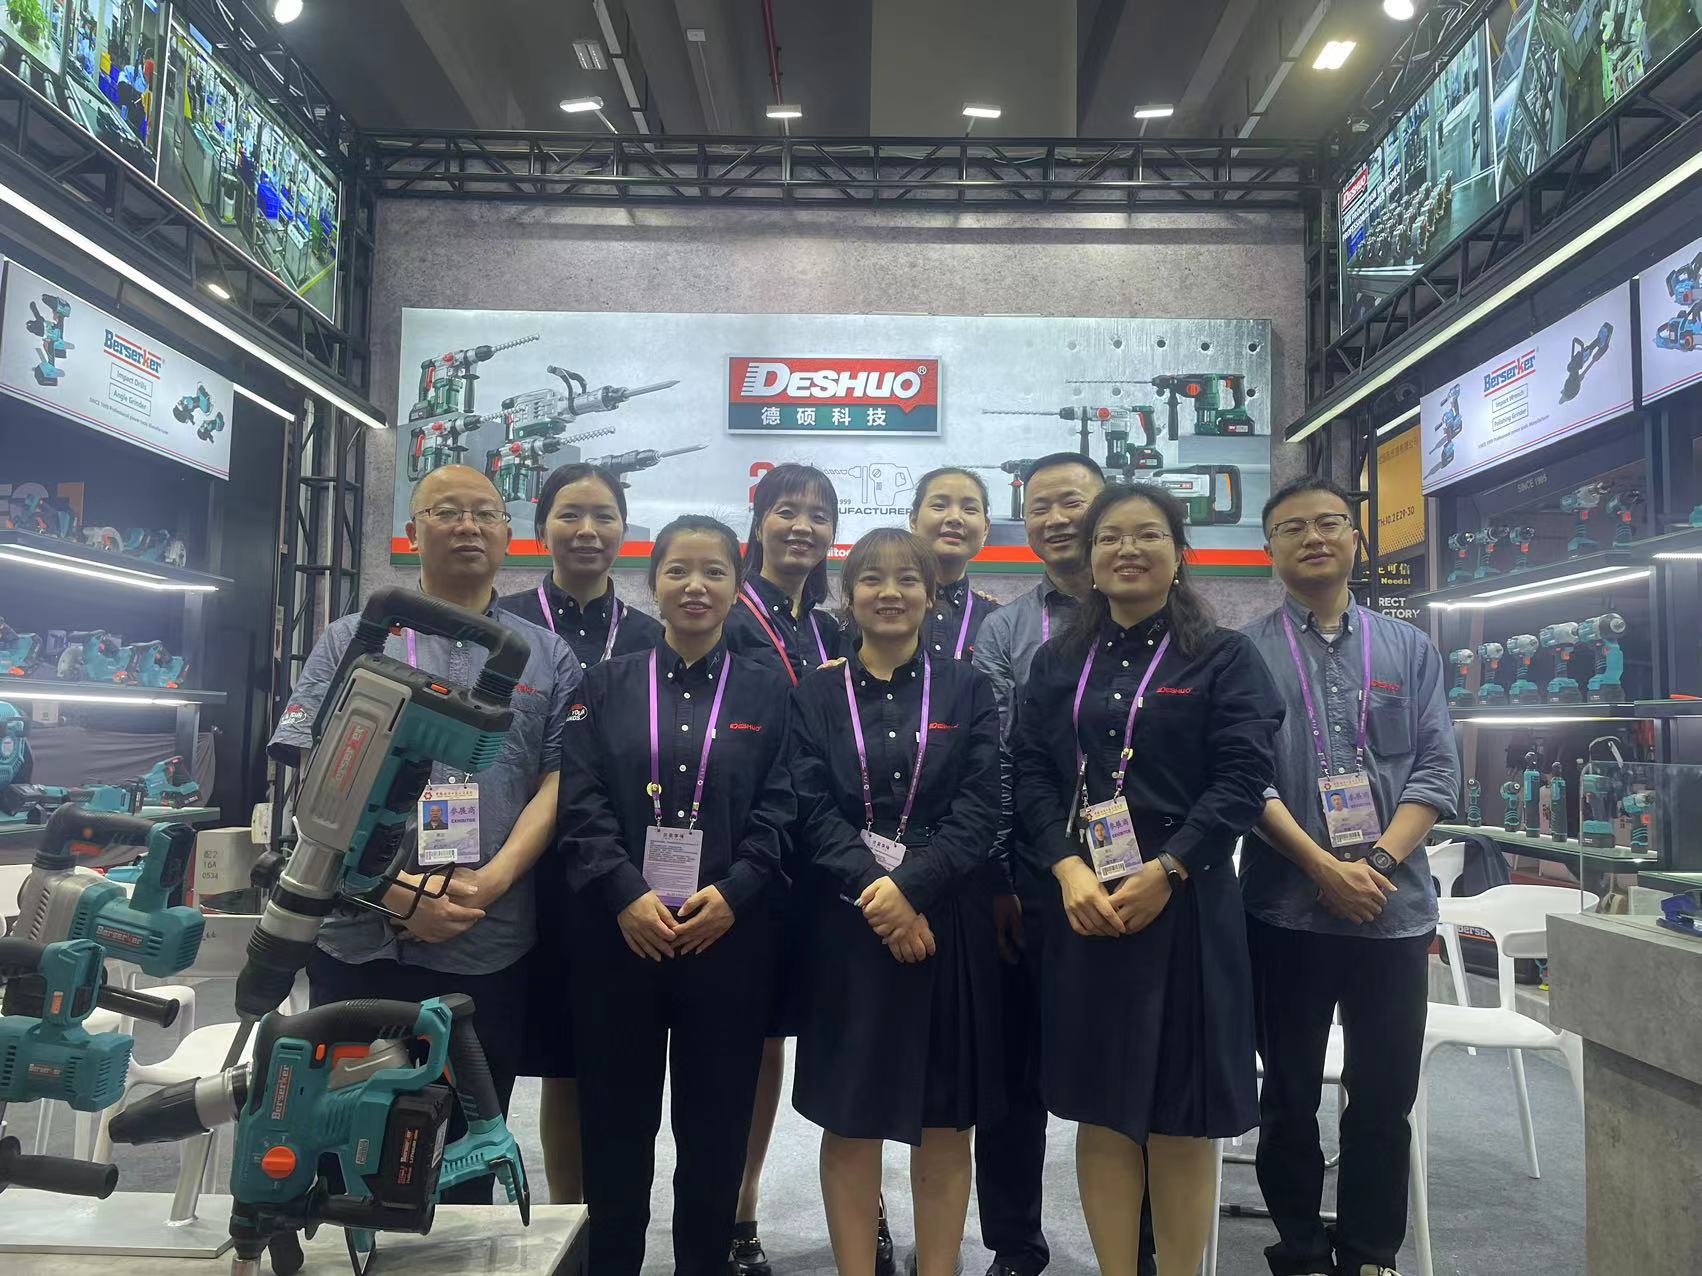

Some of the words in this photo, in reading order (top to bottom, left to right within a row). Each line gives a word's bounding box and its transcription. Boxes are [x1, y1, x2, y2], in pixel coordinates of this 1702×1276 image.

[104, 328, 162, 374] Berserker
[116, 370, 134, 384] Impact
[134, 376, 147, 391] Drills
[741, 362, 921, 399] DESHUO
[1483, 354, 1536, 393] Berserker
[113, 389, 128, 402] Angle
[128, 394, 147, 410] Grinder
[1495, 396, 1509, 408] Impact
[761, 406, 887, 426] 德硕科技
[1511, 408, 1527, 420] Grinder
[1517, 479, 1534, 493] SINCE
[838, 507, 912, 515] UFACTURER
[1381, 609, 1420, 618] CTORY
[271, 1064, 290, 1120] Berserker
